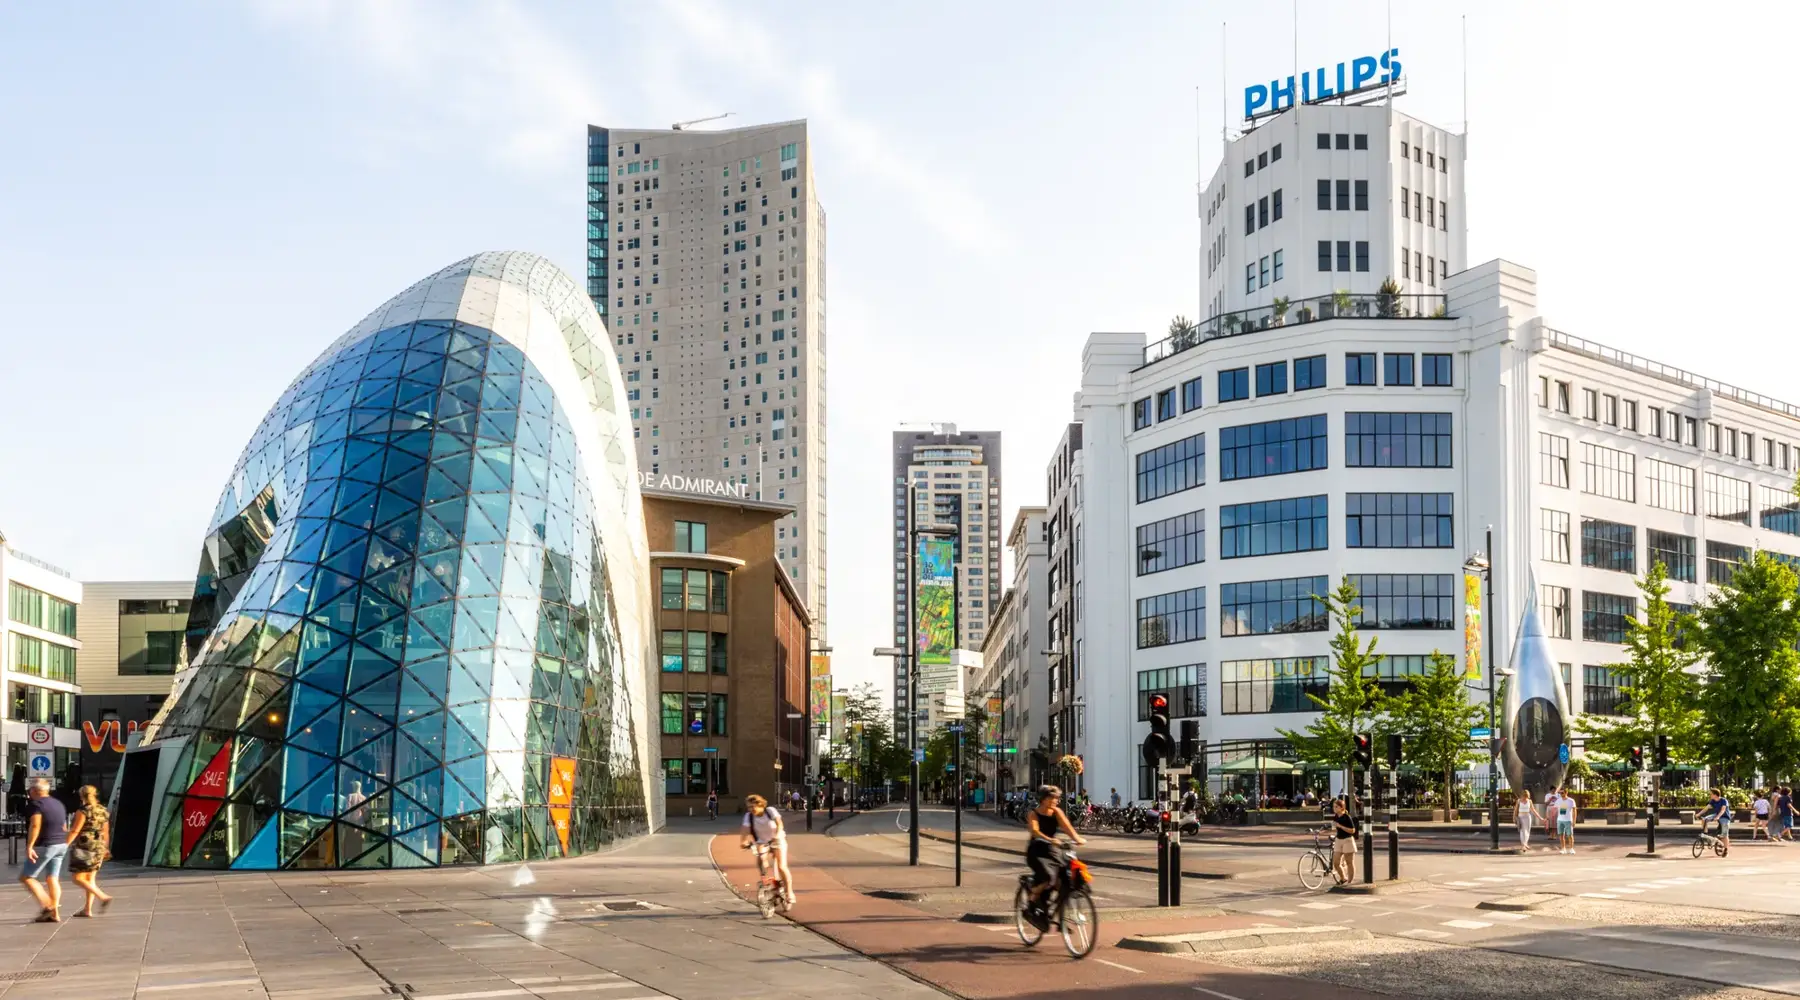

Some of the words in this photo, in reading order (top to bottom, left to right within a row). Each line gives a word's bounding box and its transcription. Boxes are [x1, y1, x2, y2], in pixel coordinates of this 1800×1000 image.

[1245, 48, 1402, 117] PHILIPS
[659, 473, 748, 498] ADMIRANT
[1243, 658, 1313, 678] IGLUU
[82, 720, 151, 752] VU
[202, 771, 224, 787] SALE
[186, 810, 208, 828] -60%
